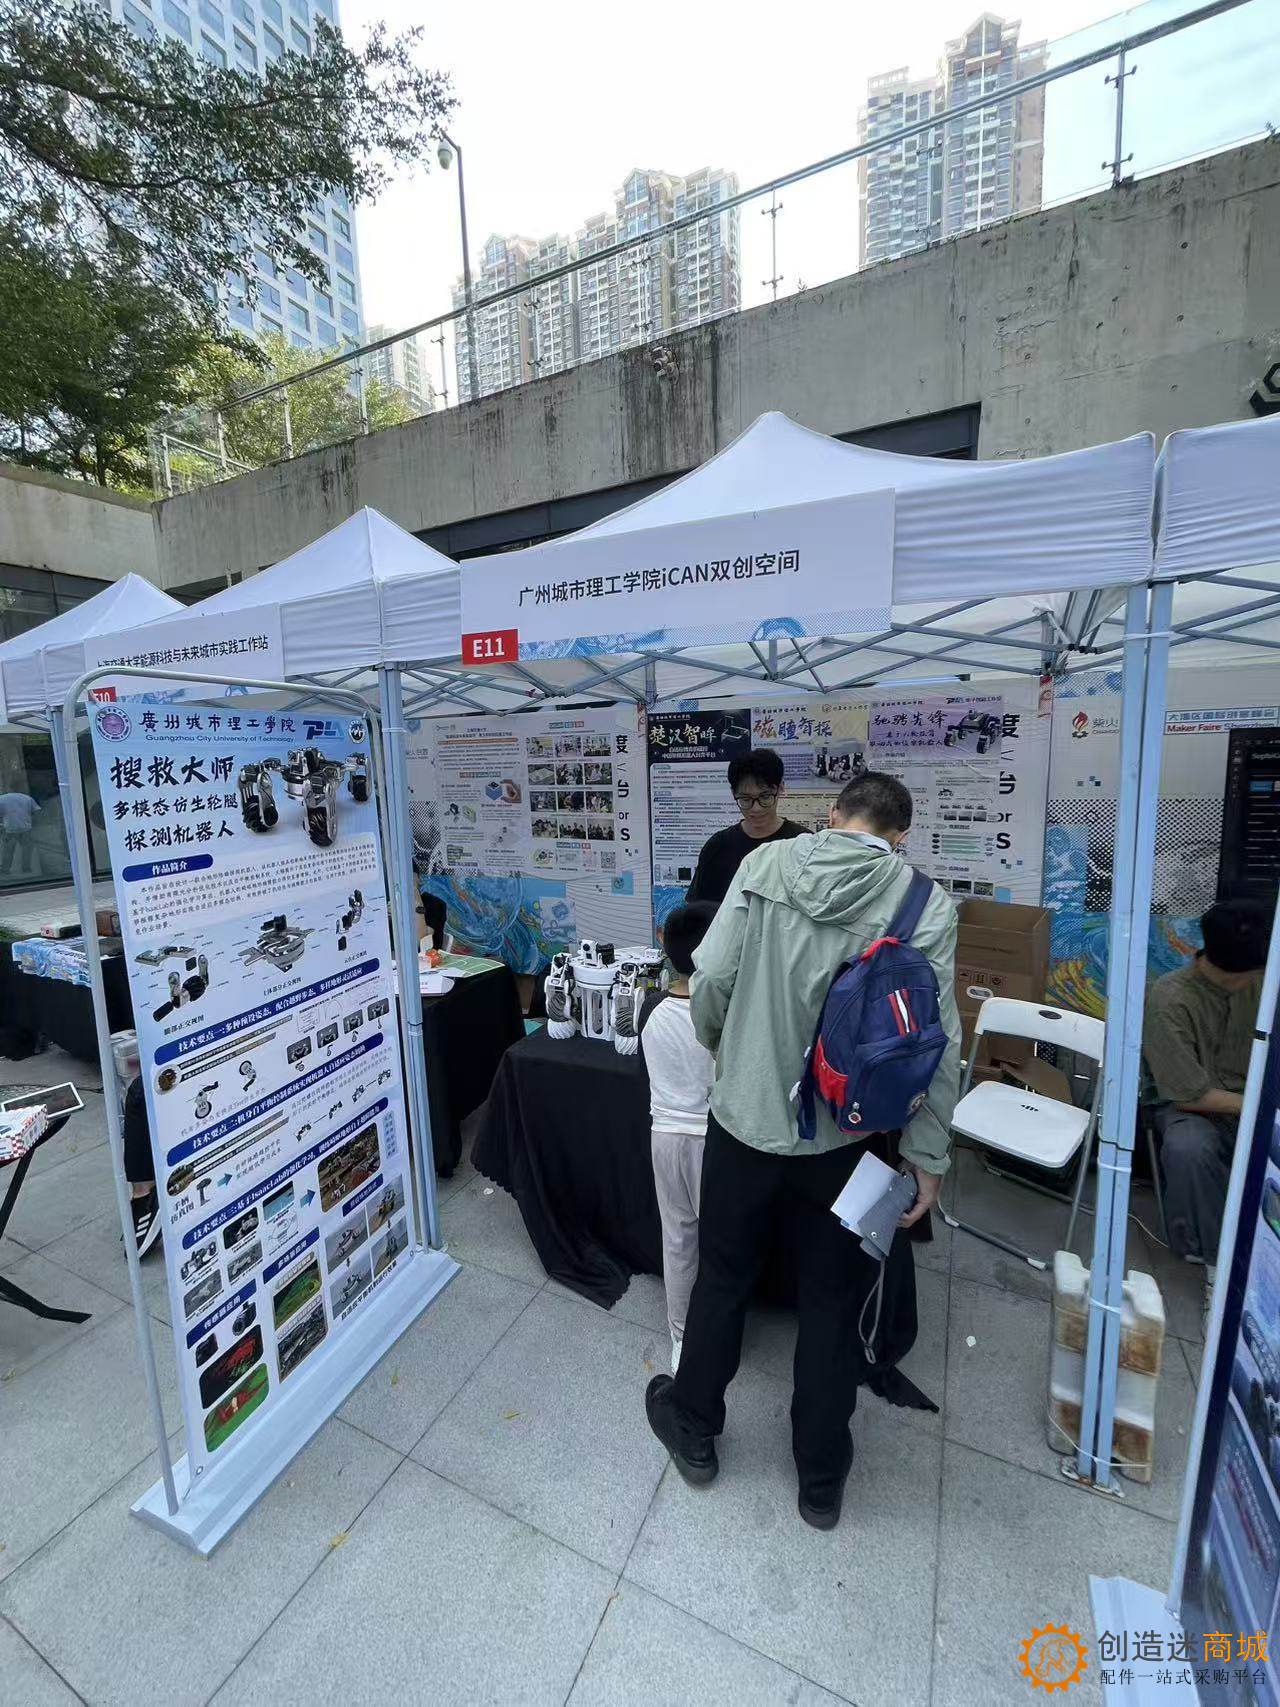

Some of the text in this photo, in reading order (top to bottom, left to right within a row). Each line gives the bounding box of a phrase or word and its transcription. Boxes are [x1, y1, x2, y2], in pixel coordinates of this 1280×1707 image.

[518, 549, 801, 607] 广州城市理工学院iCAN双创空间
[473, 638, 505, 658] E11
[145, 734, 295, 743] Guangzhou City University of Technology
[1167, 723, 1196, 732] Maker
[1198, 723, 1222, 731] Faire
[110, 755, 235, 790] 搜救大师
[113, 792, 239, 820] 多模态仿生轮腿
[618, 812, 630, 820] or
[124, 820, 235, 852] 探测机器人
